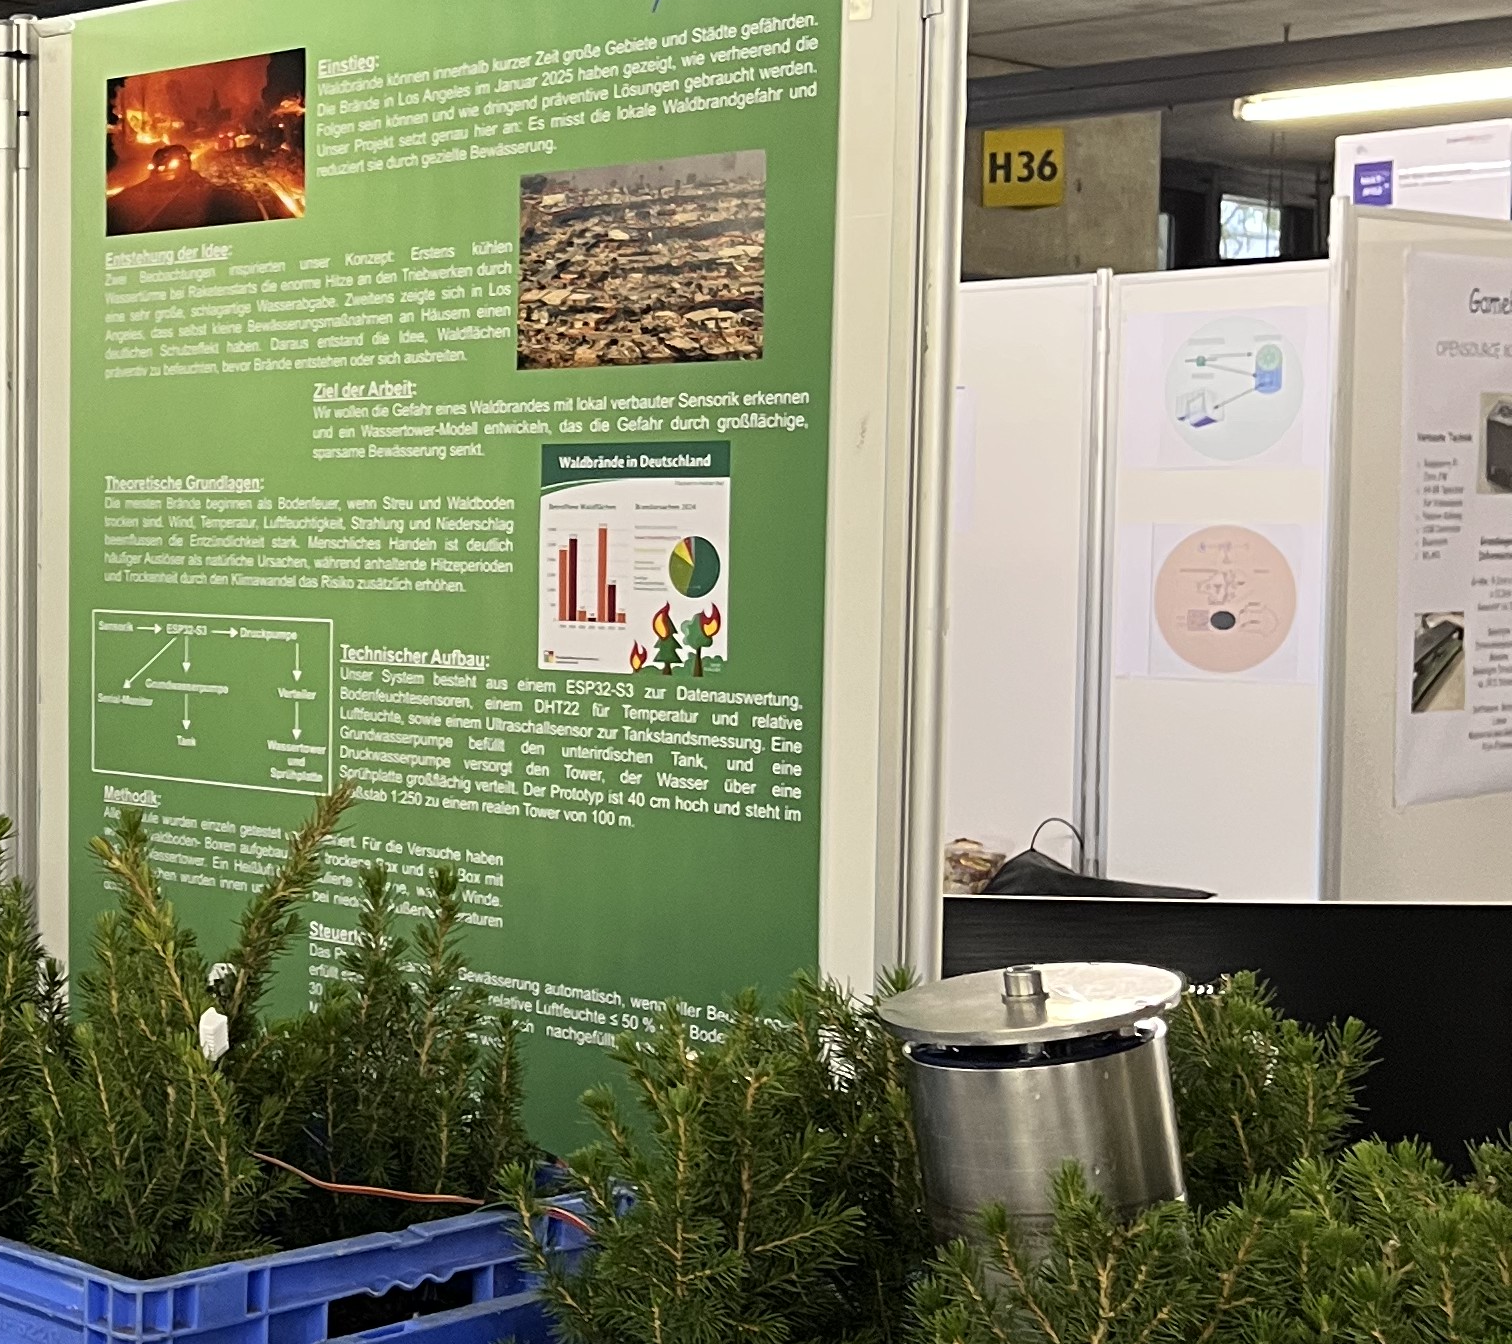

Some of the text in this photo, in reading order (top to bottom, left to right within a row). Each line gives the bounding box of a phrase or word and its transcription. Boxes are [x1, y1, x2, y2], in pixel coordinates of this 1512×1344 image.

[316, 102, 336, 117] Die
[339, 96, 380, 114] Brände
[383, 95, 394, 108] in
[397, 91, 420, 106] Los
[421, 84, 471, 103] Angeles
[474, 82, 491, 95] im
[493, 75, 539, 93] Januar
[540, 67, 574, 87] 2025
[576, 64, 619, 81] haben
[680, 50, 706, 67] wie
[709, 37, 791, 63] verheerend
[794, 35, 819, 52] die
[1468, 287, 1512, 315] Game
[311, 382, 339, 402] Ziel
[340, 381, 366, 401] der
[557, 453, 711, 469] Waldbrände in Deutschland
[103, 474, 183, 493] Theoretische
[339, 643, 429, 667] Technischer
[339, 666, 374, 681] Unser
[380, 668, 425, 686] System
[432, 671, 477, 688] besteht
[484, 677, 508, 690] aus
[516, 677, 556, 693] einem
[565, 678, 635, 698] ESP32-S3
[643, 686, 667, 700] zur
[484, 696, 523, 712] einem
[533, 697, 580, 716] DHT22
[591, 701, 611, 718] für
[621, 703, 699, 724] Temperatur
[710, 710, 739, 727] und
[751, 712, 803, 731] relative
[407, 712, 442, 727] sowie
[444, 713, 482, 729] einem
[485, 715, 594, 738] Ultraschallsensor
[596, 726, 619, 740] zur
[770, 735, 803, 754] Eine
[338, 763, 403, 784] Sprühplatte
[405, 771, 472, 793] großflächig
[522, 780, 546, 797] Der
[549, 783, 604, 806] Prototyp
[607, 789, 624, 805] ist
[626, 791, 645, 807] 40
[648, 795, 671, 809] cm
[674, 794, 709, 813] hoch
[713, 800, 741, 816] und
[744, 802, 781, 820] steht
[783, 804, 802, 822] im
